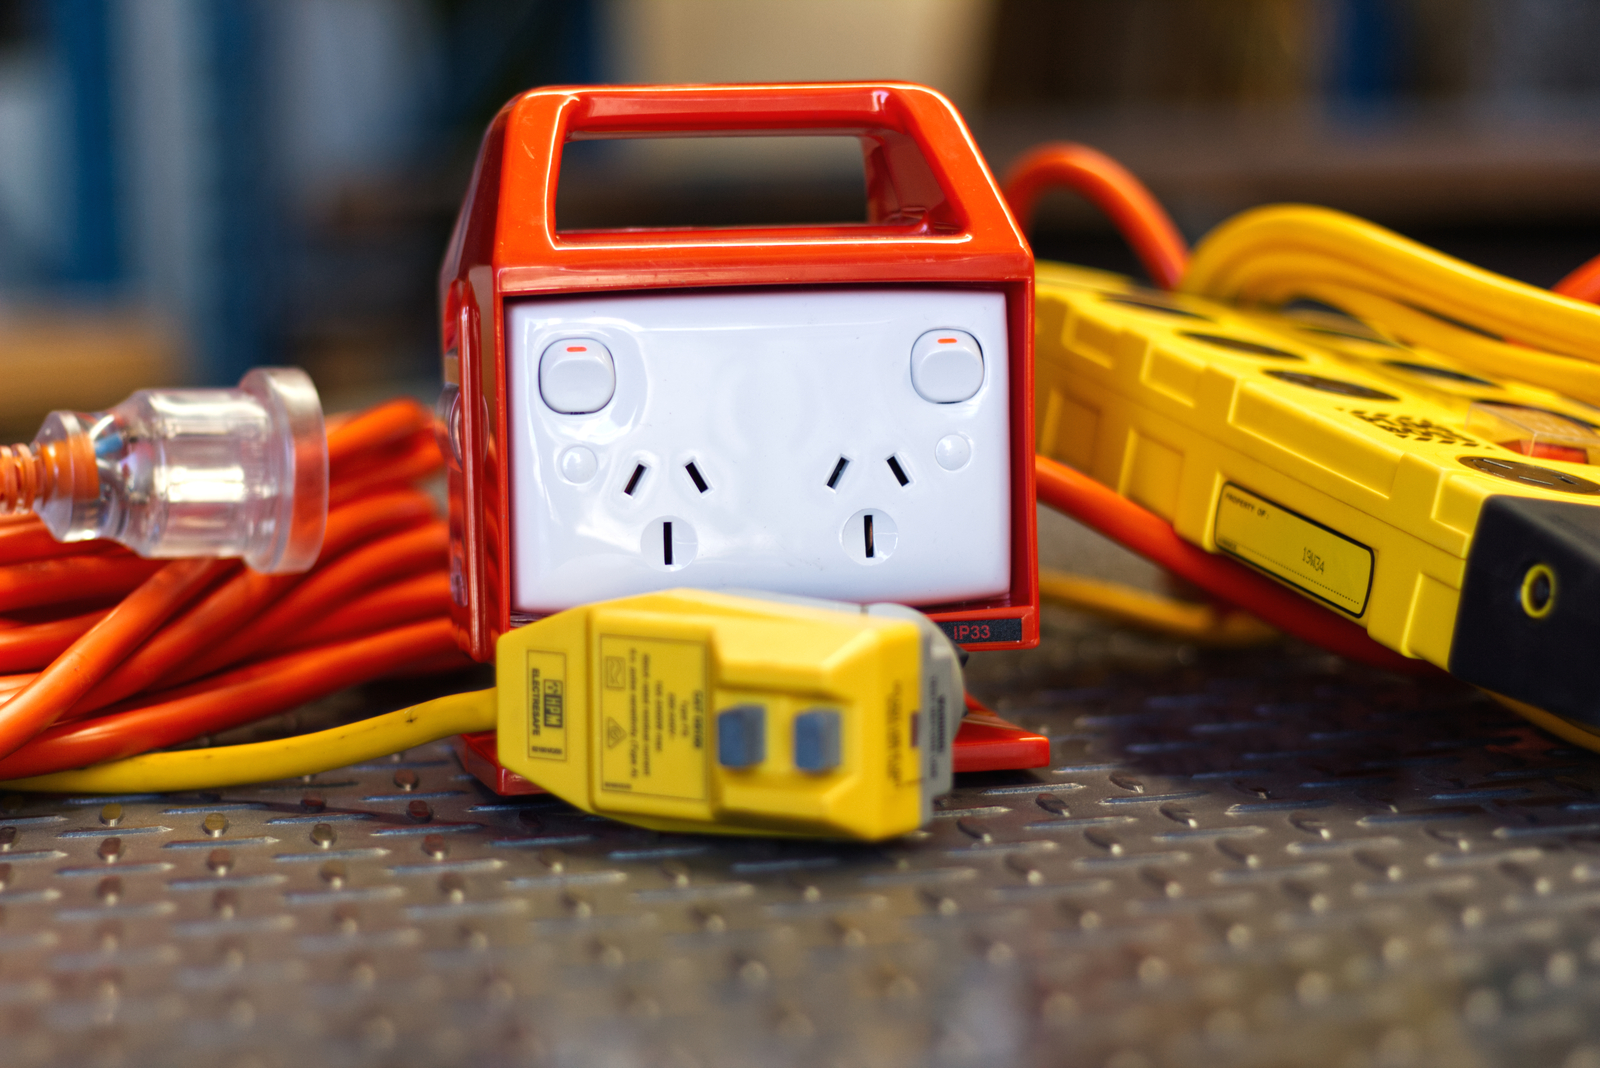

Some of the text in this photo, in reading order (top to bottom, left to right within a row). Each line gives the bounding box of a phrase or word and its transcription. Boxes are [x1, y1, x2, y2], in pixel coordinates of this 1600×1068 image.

[1225, 492, 1255, 512] PROPERTY
[953, 624, 991, 640] IP33
[532, 668, 541, 736] ELECTRESAFE
[545, 696, 561, 726] HPM
